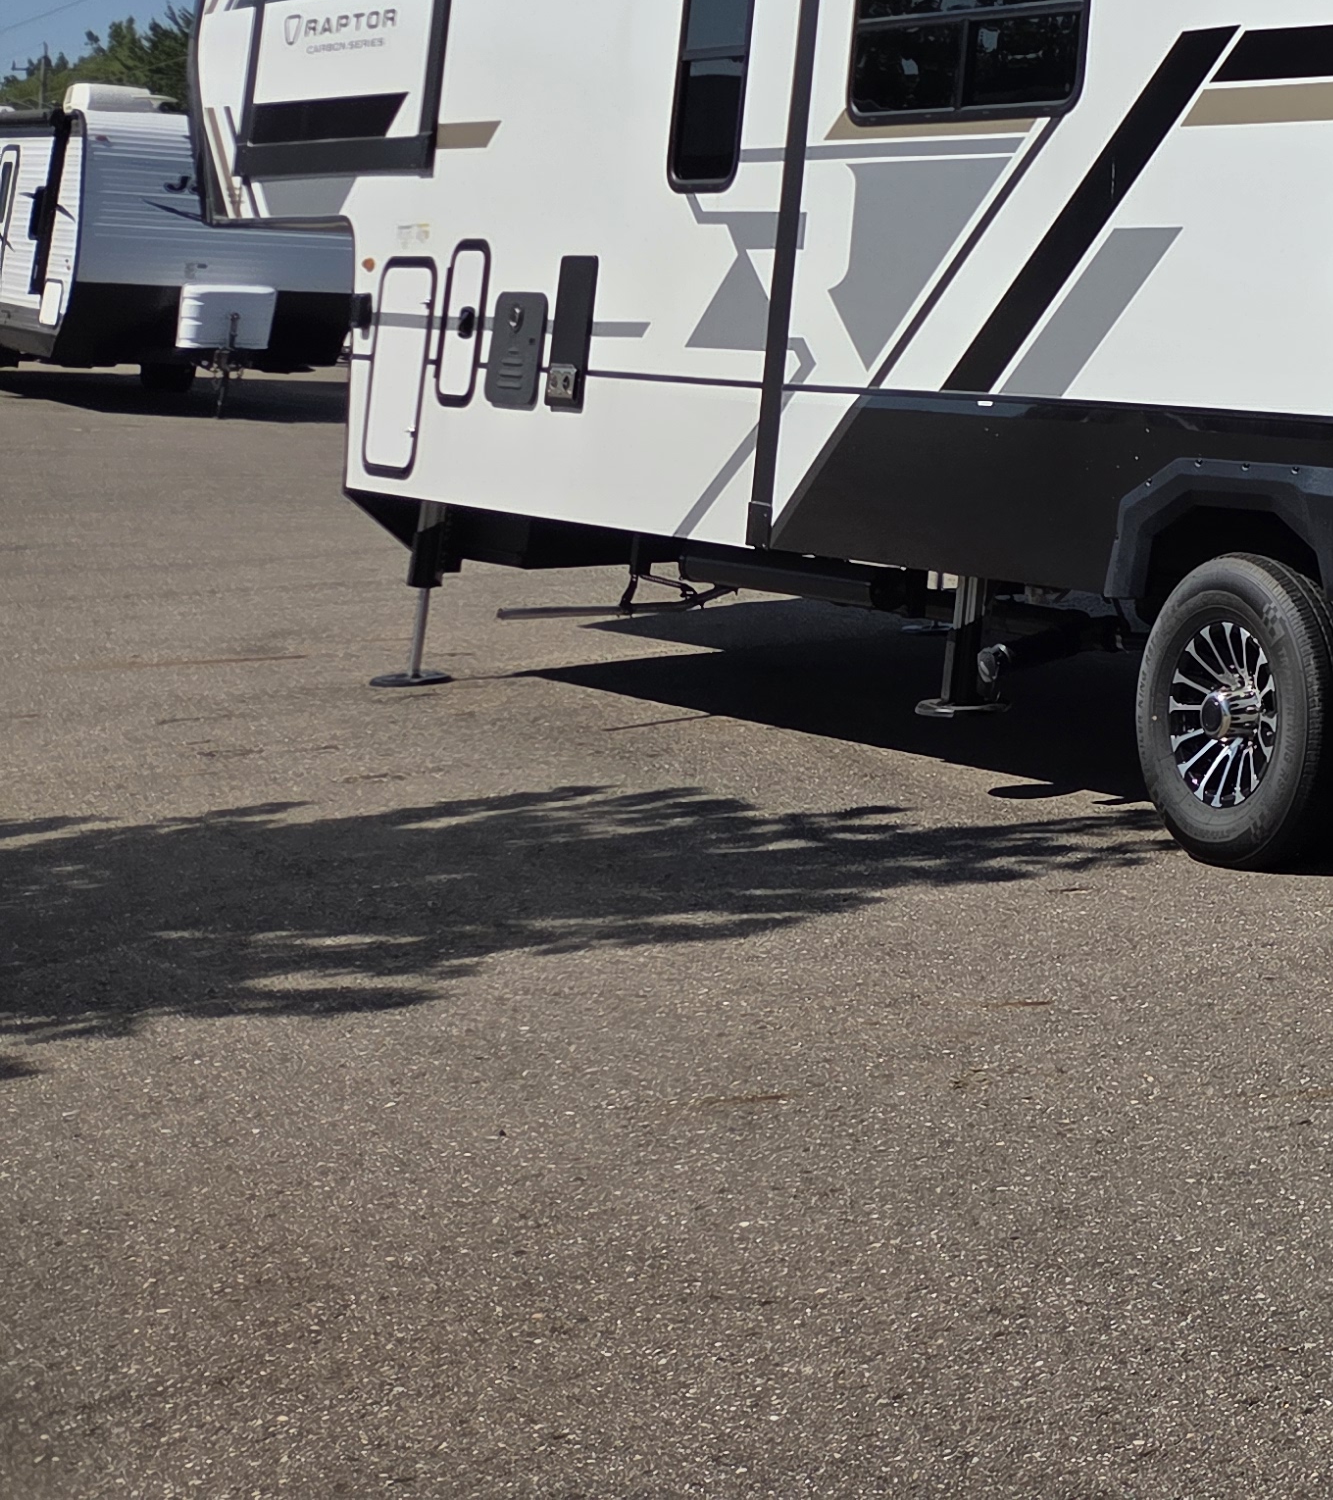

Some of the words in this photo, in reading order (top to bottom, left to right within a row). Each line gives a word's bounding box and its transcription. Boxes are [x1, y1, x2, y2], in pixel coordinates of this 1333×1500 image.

[303, 8, 398, 37] RAPTOR
[306, 41, 345, 54] CARBON
[347, 37, 385, 50] SERIES
